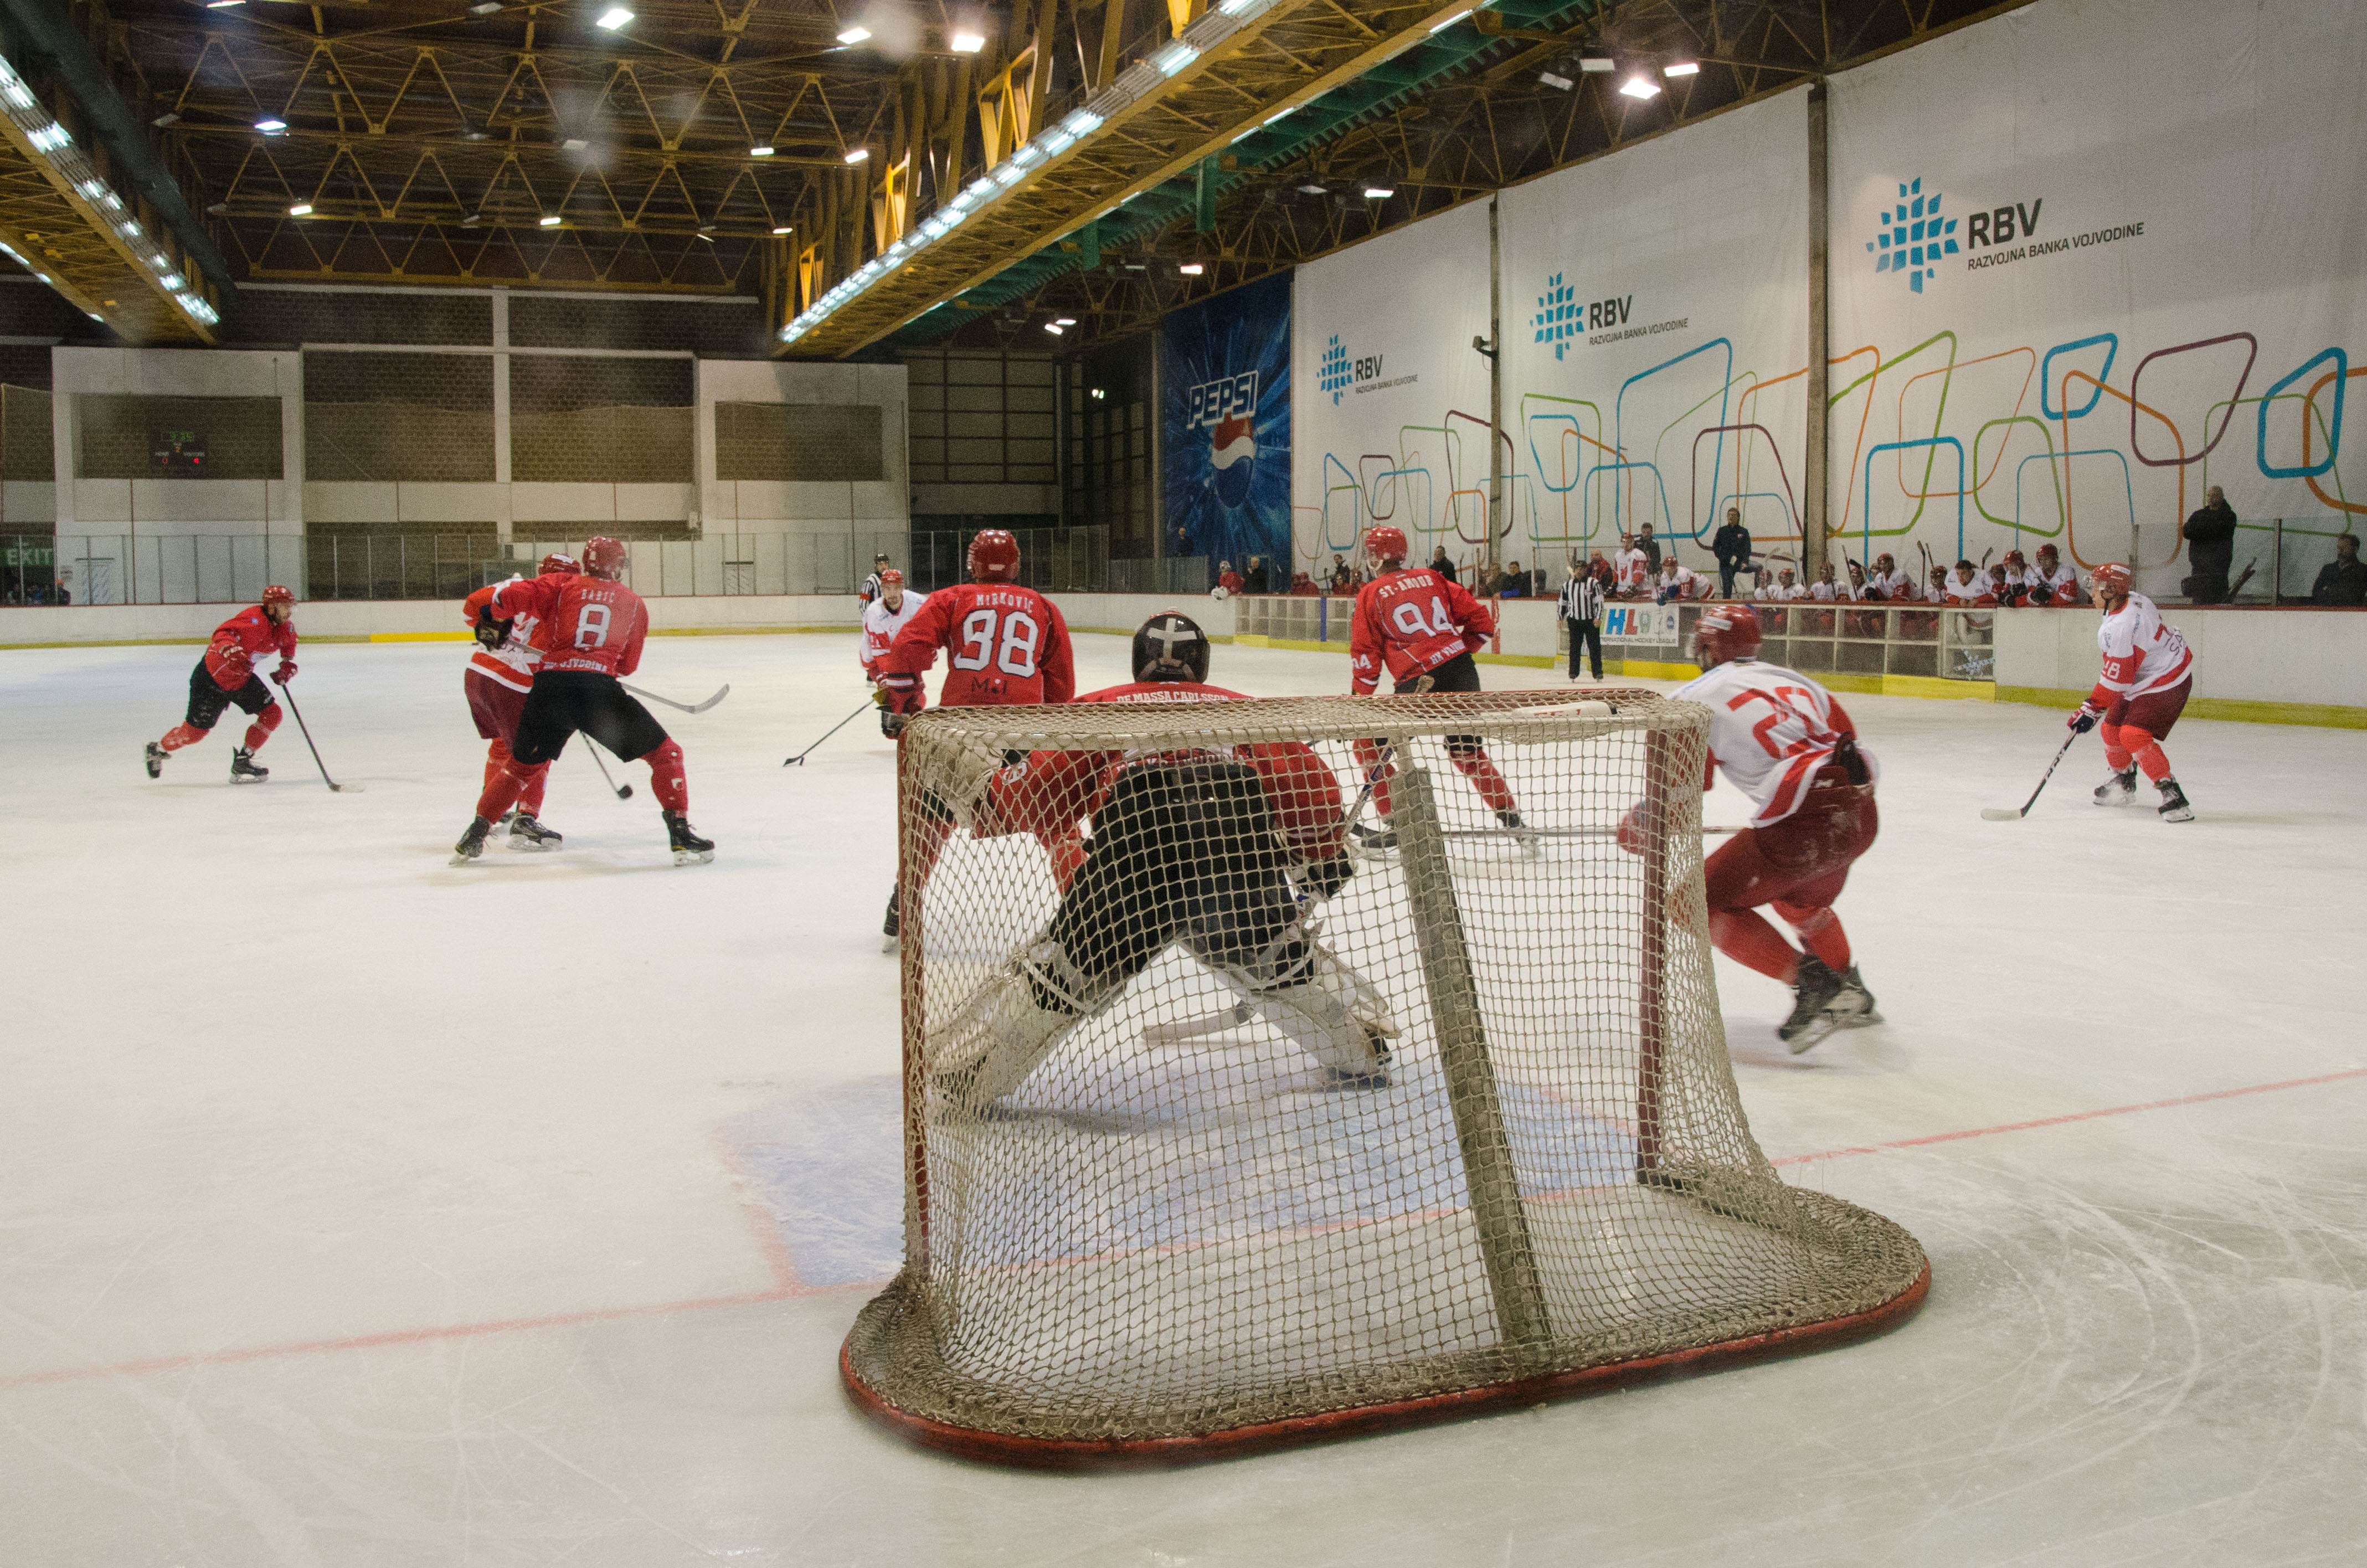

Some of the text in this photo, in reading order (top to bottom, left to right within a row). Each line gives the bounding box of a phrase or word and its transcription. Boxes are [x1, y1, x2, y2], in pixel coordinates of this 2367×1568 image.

[1969, 198, 2042, 249] RBV
[1968, 222, 2145, 270] RAZVOJNA BANKA VOJVODINE
[1590, 295, 1632, 330] RBV
[1589, 318, 1689, 346] RAZVOJNA BANKA VOJVODINE
[1356, 354, 1383, 382] RBV
[1187, 370, 1259, 429] PEPSI
[7, 548, 53, 566] EXIT
[1378, 575, 1434, 598] ST-AMOUR
[574, 603, 612, 647] 8
[1392, 595, 1459, 637] 94
[1133, 691, 1171, 702] MASSA
[1726, 685, 1840, 760] 20
